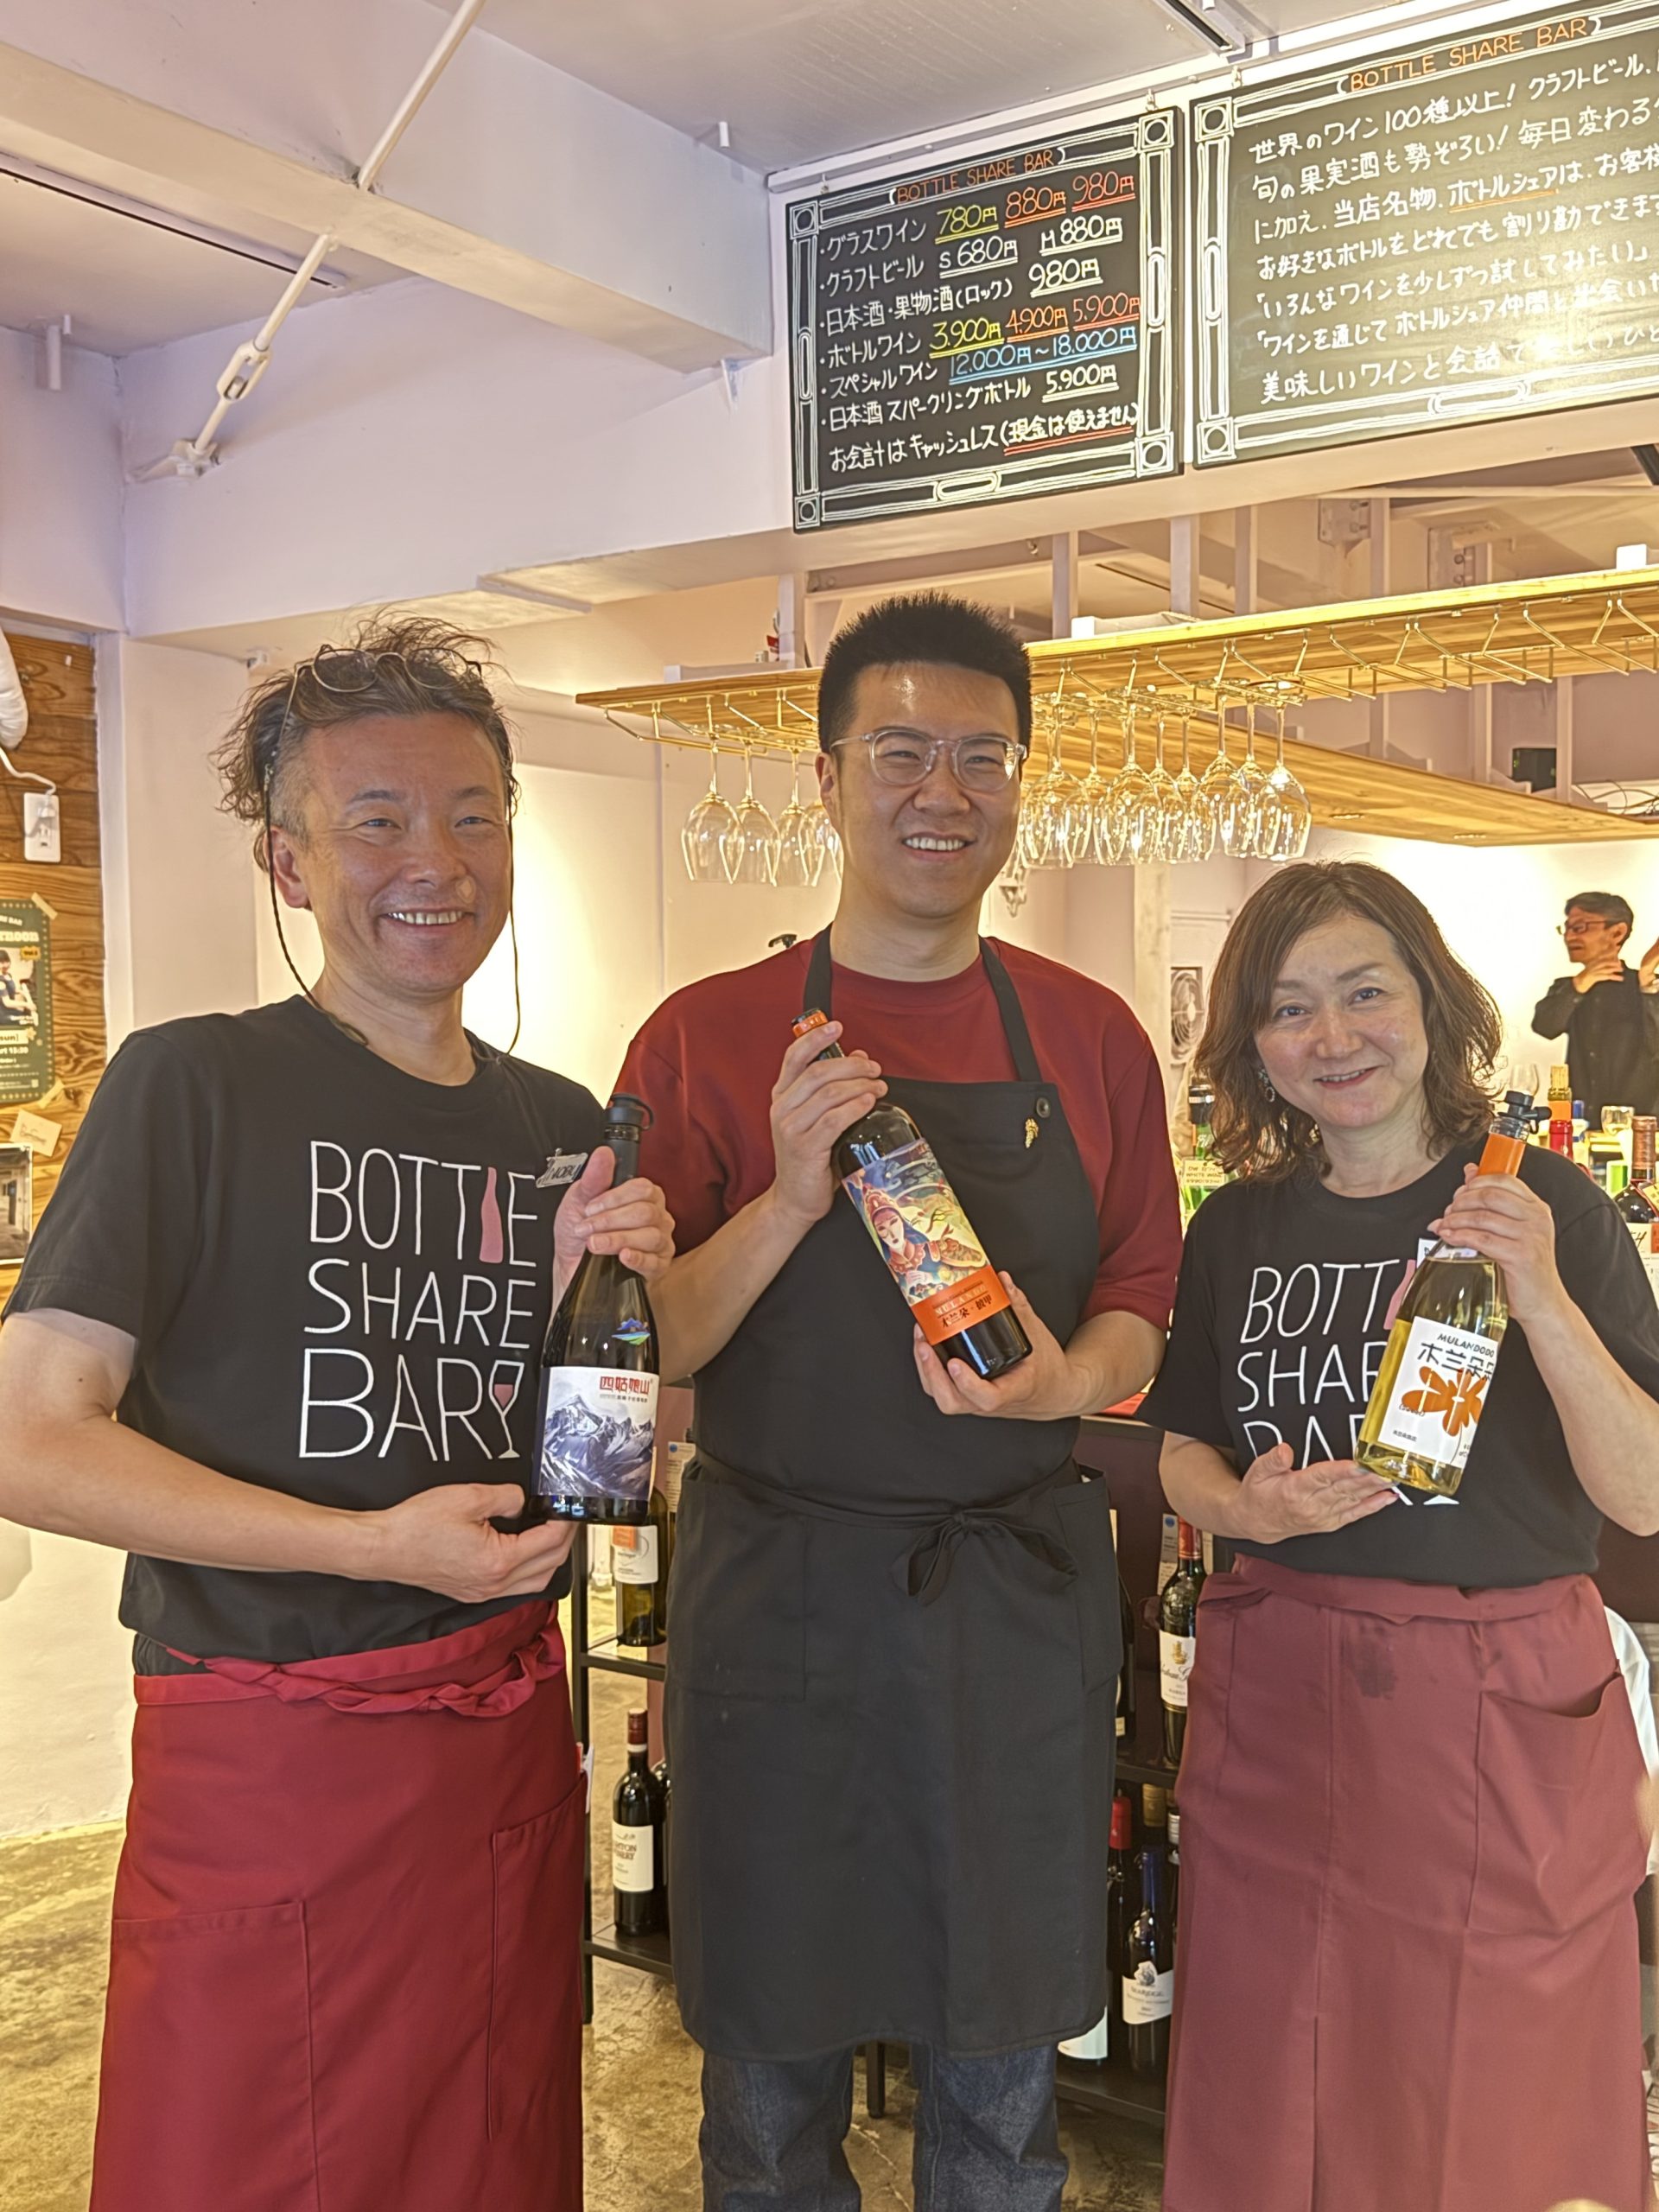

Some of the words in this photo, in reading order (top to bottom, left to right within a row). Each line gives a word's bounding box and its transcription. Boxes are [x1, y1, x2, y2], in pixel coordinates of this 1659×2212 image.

[1351, 54, 1437, 92] BOTTLE
[1449, 32, 1524, 67] SHARE
[1537, 18, 1586, 48] BAR
[897, 173, 961, 204] BOTTLE
[967, 157, 1017, 187] SHARE
[1024, 149, 1054, 173] BAR
[826, 218, 926, 261] グラスワイン
[936, 205, 997, 235] 780円
[1005, 186, 1066, 219] 880円
[1072, 170, 1135, 205] 980円
[826, 253, 925, 297] クラフトビール
[957, 235, 1018, 266] 680円
[1060, 215, 1122, 245] 880円
[1028, 257, 1100, 293] 980円
[827, 331, 921, 369] ボトルワイン
[303, 1258, 537, 1350] SHARE
[299, 1347, 493, 1462] BAR
[599, 1375, 650, 1396] 四姑娘山
